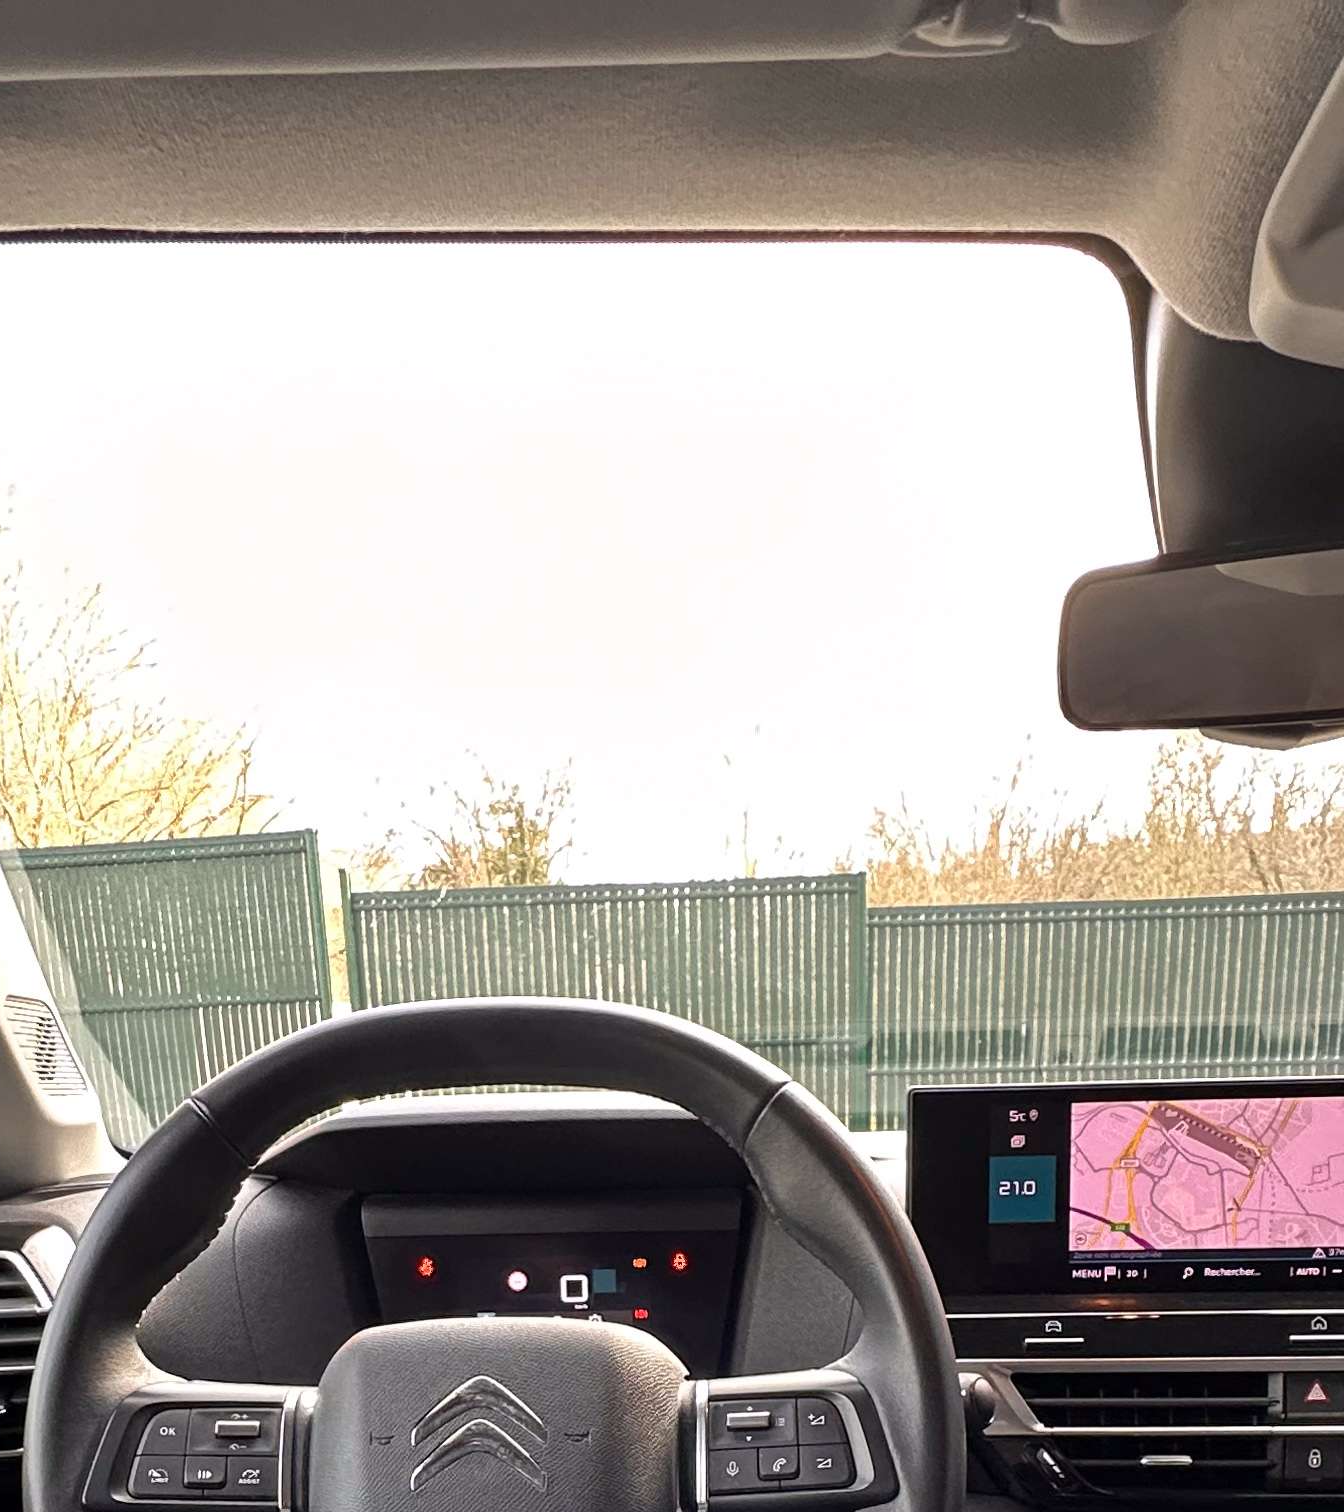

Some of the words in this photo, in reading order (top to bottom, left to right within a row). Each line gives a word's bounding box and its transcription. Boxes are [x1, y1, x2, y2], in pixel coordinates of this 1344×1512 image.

[998, 1180, 1037, 1196] 21.0
[1071, 1269, 1102, 1279] MENU
[159, 1426, 177, 1436] OK
